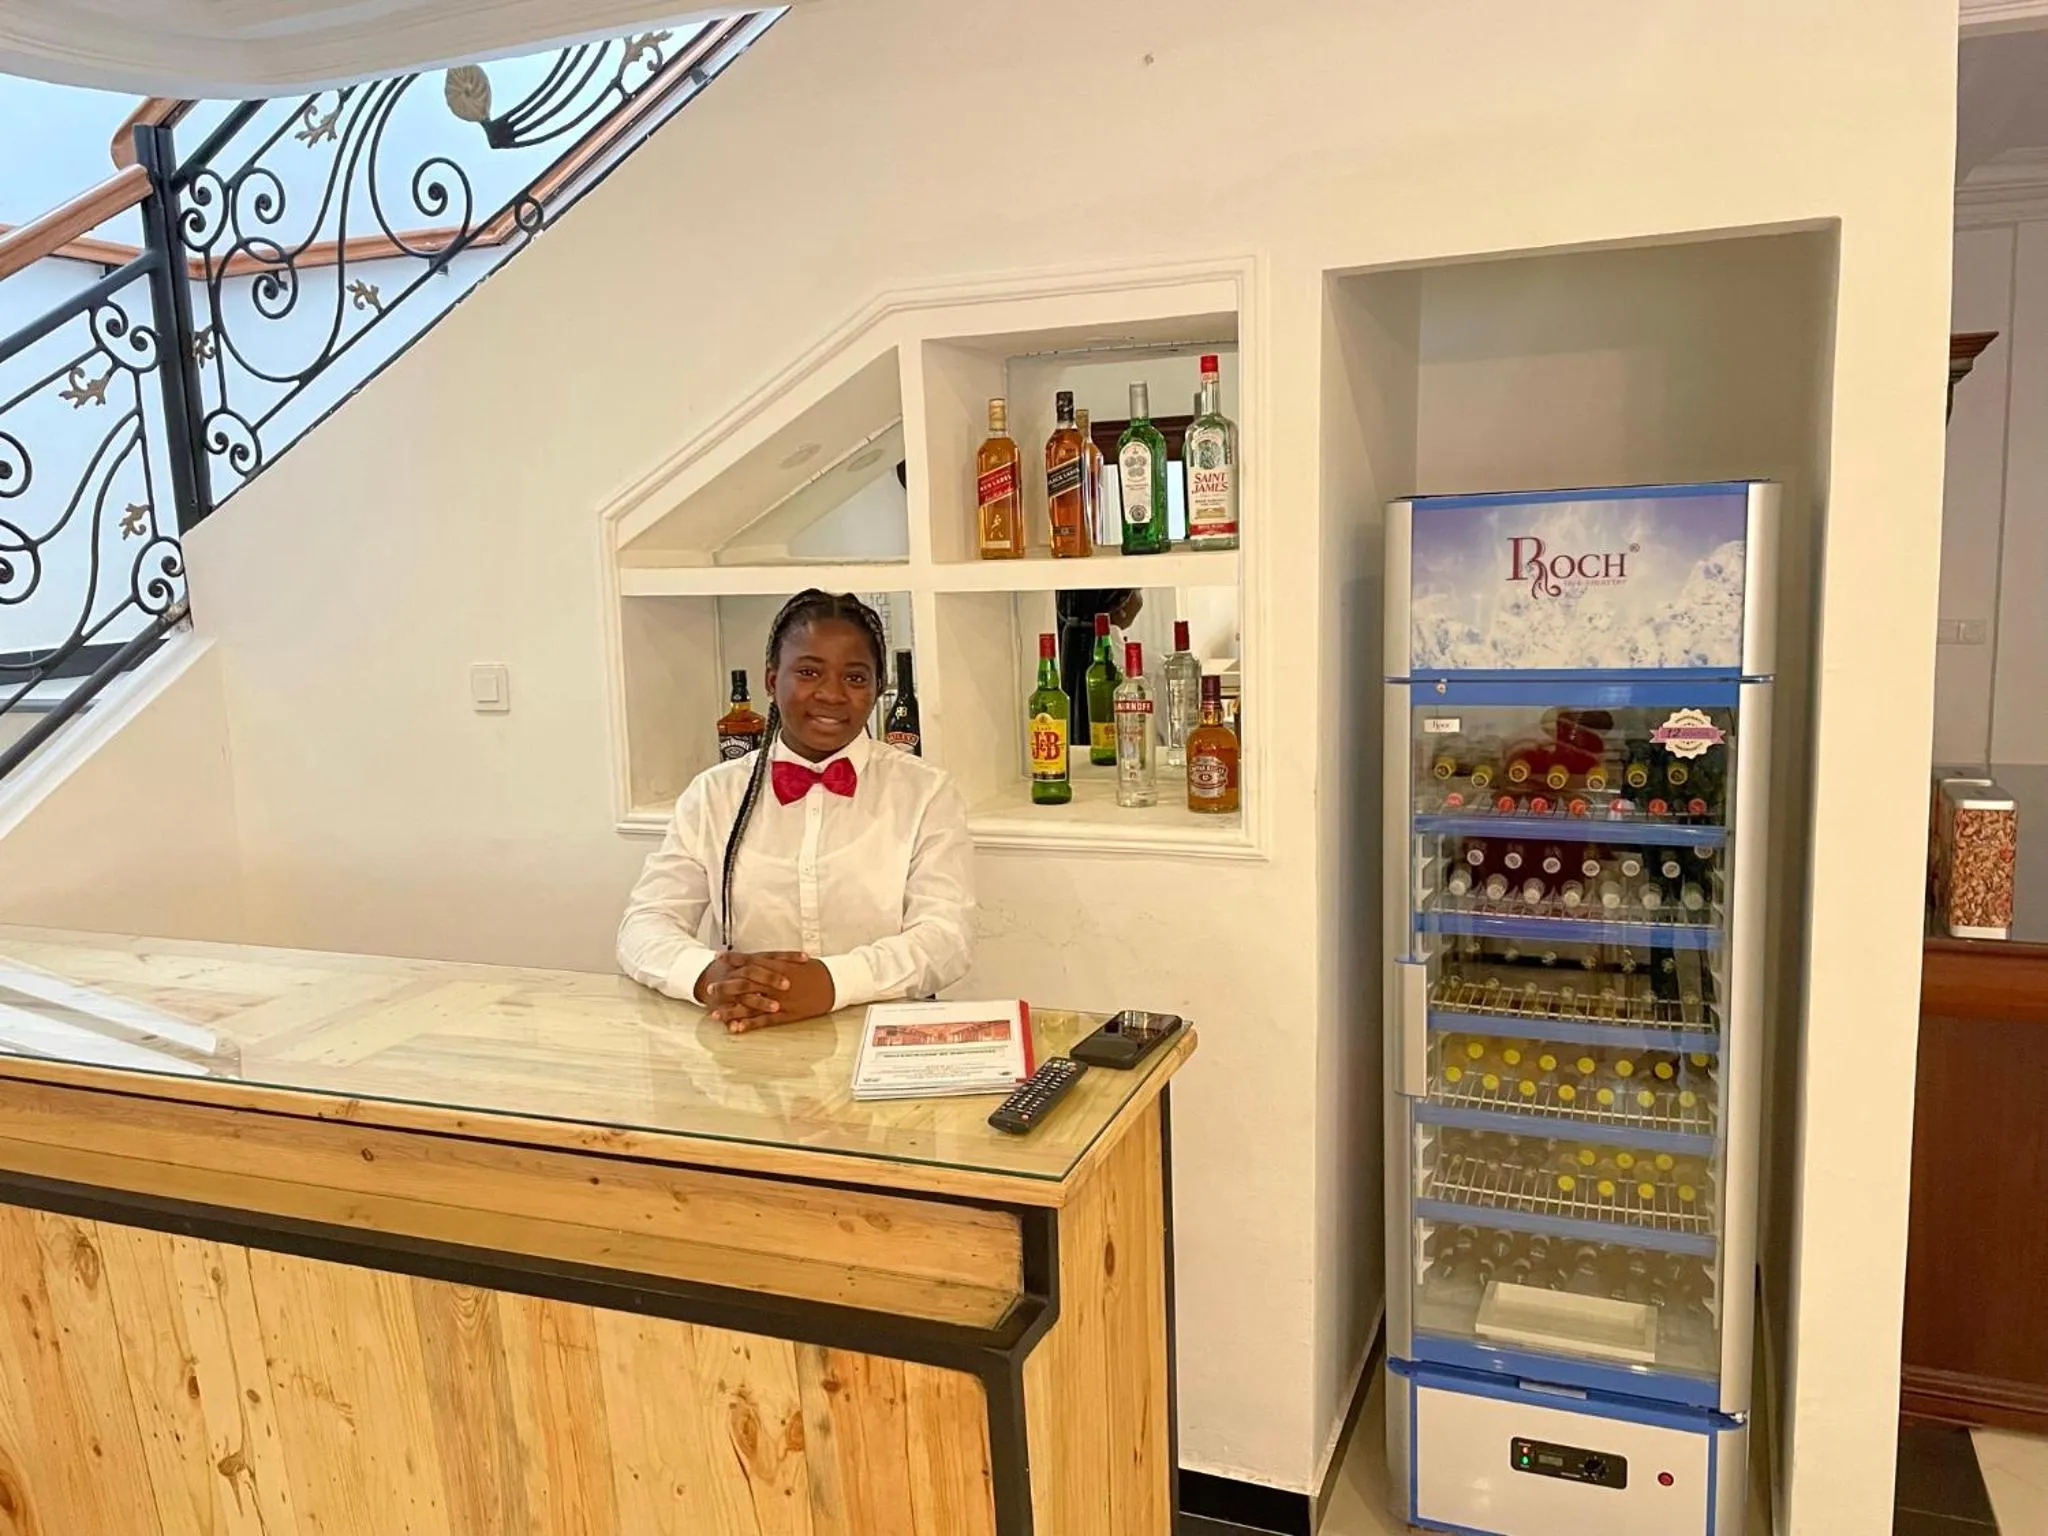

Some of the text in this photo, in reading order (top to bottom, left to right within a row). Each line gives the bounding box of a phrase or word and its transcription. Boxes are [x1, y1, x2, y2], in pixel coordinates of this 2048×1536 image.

[1194, 471, 1226, 483] SAINT
[1191, 482, 1229, 494] JAMES
[1505, 536, 1628, 600] ROCH
[1031, 731, 1061, 761] J&B
